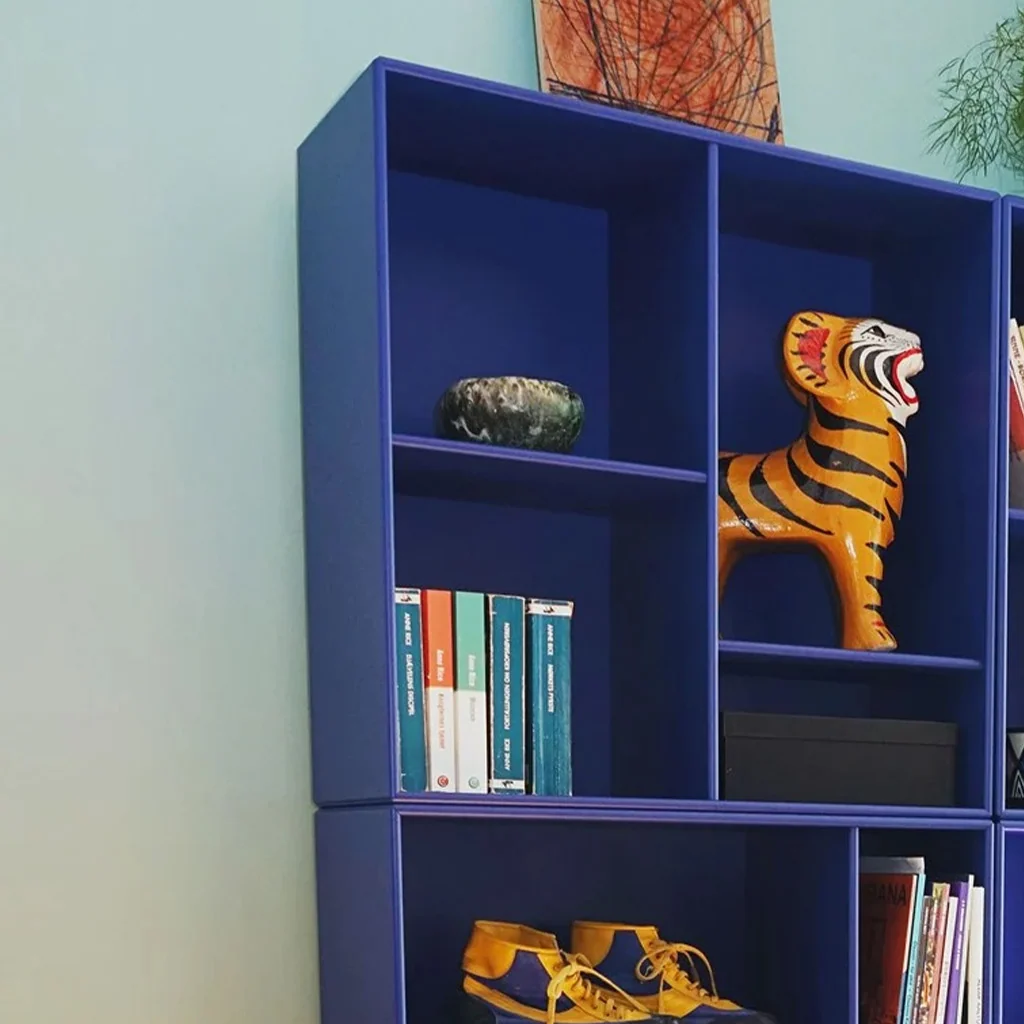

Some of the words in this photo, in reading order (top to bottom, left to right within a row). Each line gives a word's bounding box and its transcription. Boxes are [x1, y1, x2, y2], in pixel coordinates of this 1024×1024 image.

[546, 624, 554, 642] ANNE
[436, 649, 444, 665] Anne
[468, 655, 476, 671] Anne
[437, 667, 445, 681] Rice
